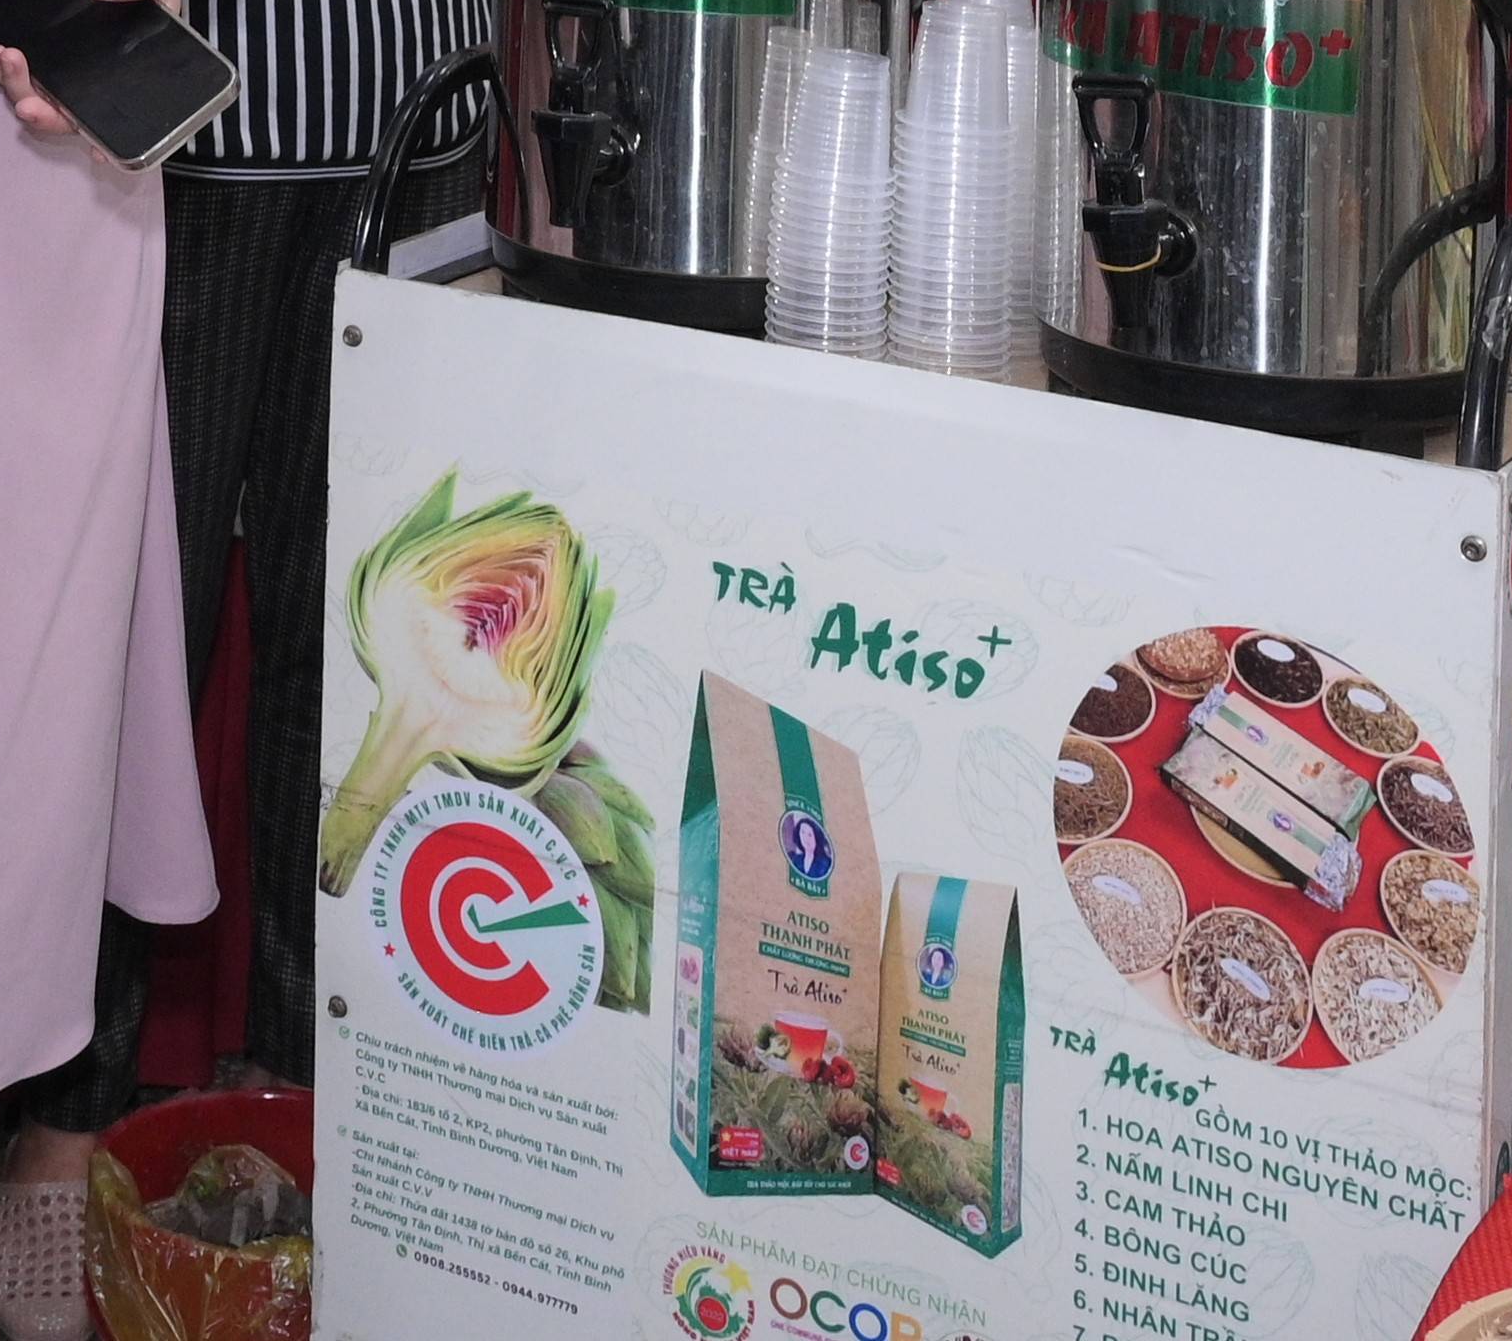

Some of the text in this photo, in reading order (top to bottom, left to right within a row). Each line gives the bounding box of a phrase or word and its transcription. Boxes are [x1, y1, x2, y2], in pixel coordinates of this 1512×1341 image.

[1127, 10, 1353, 88] ATISO+
[712, 561, 797, 615] TRÀ
[787, 910, 830, 935] ATISO
[1049, 1025, 1097, 1057] TRÀ
[1076, 1144, 1288, 1223] 2. NẤM LINH CHI
[1077, 1108, 1466, 1233] 1. HOA ATISO NGUYÊN CHẤT
[1194, 1104, 1473, 1203] GỒM 10 VỊ THẢO MỘC:
[1075, 1180, 1247, 1247] 3. CAM THẢO
[1074, 1218, 1248, 1285] 4. BÔNG CÚC
[1074, 1253, 1251, 1322] 5. ĐINH LĂNG
